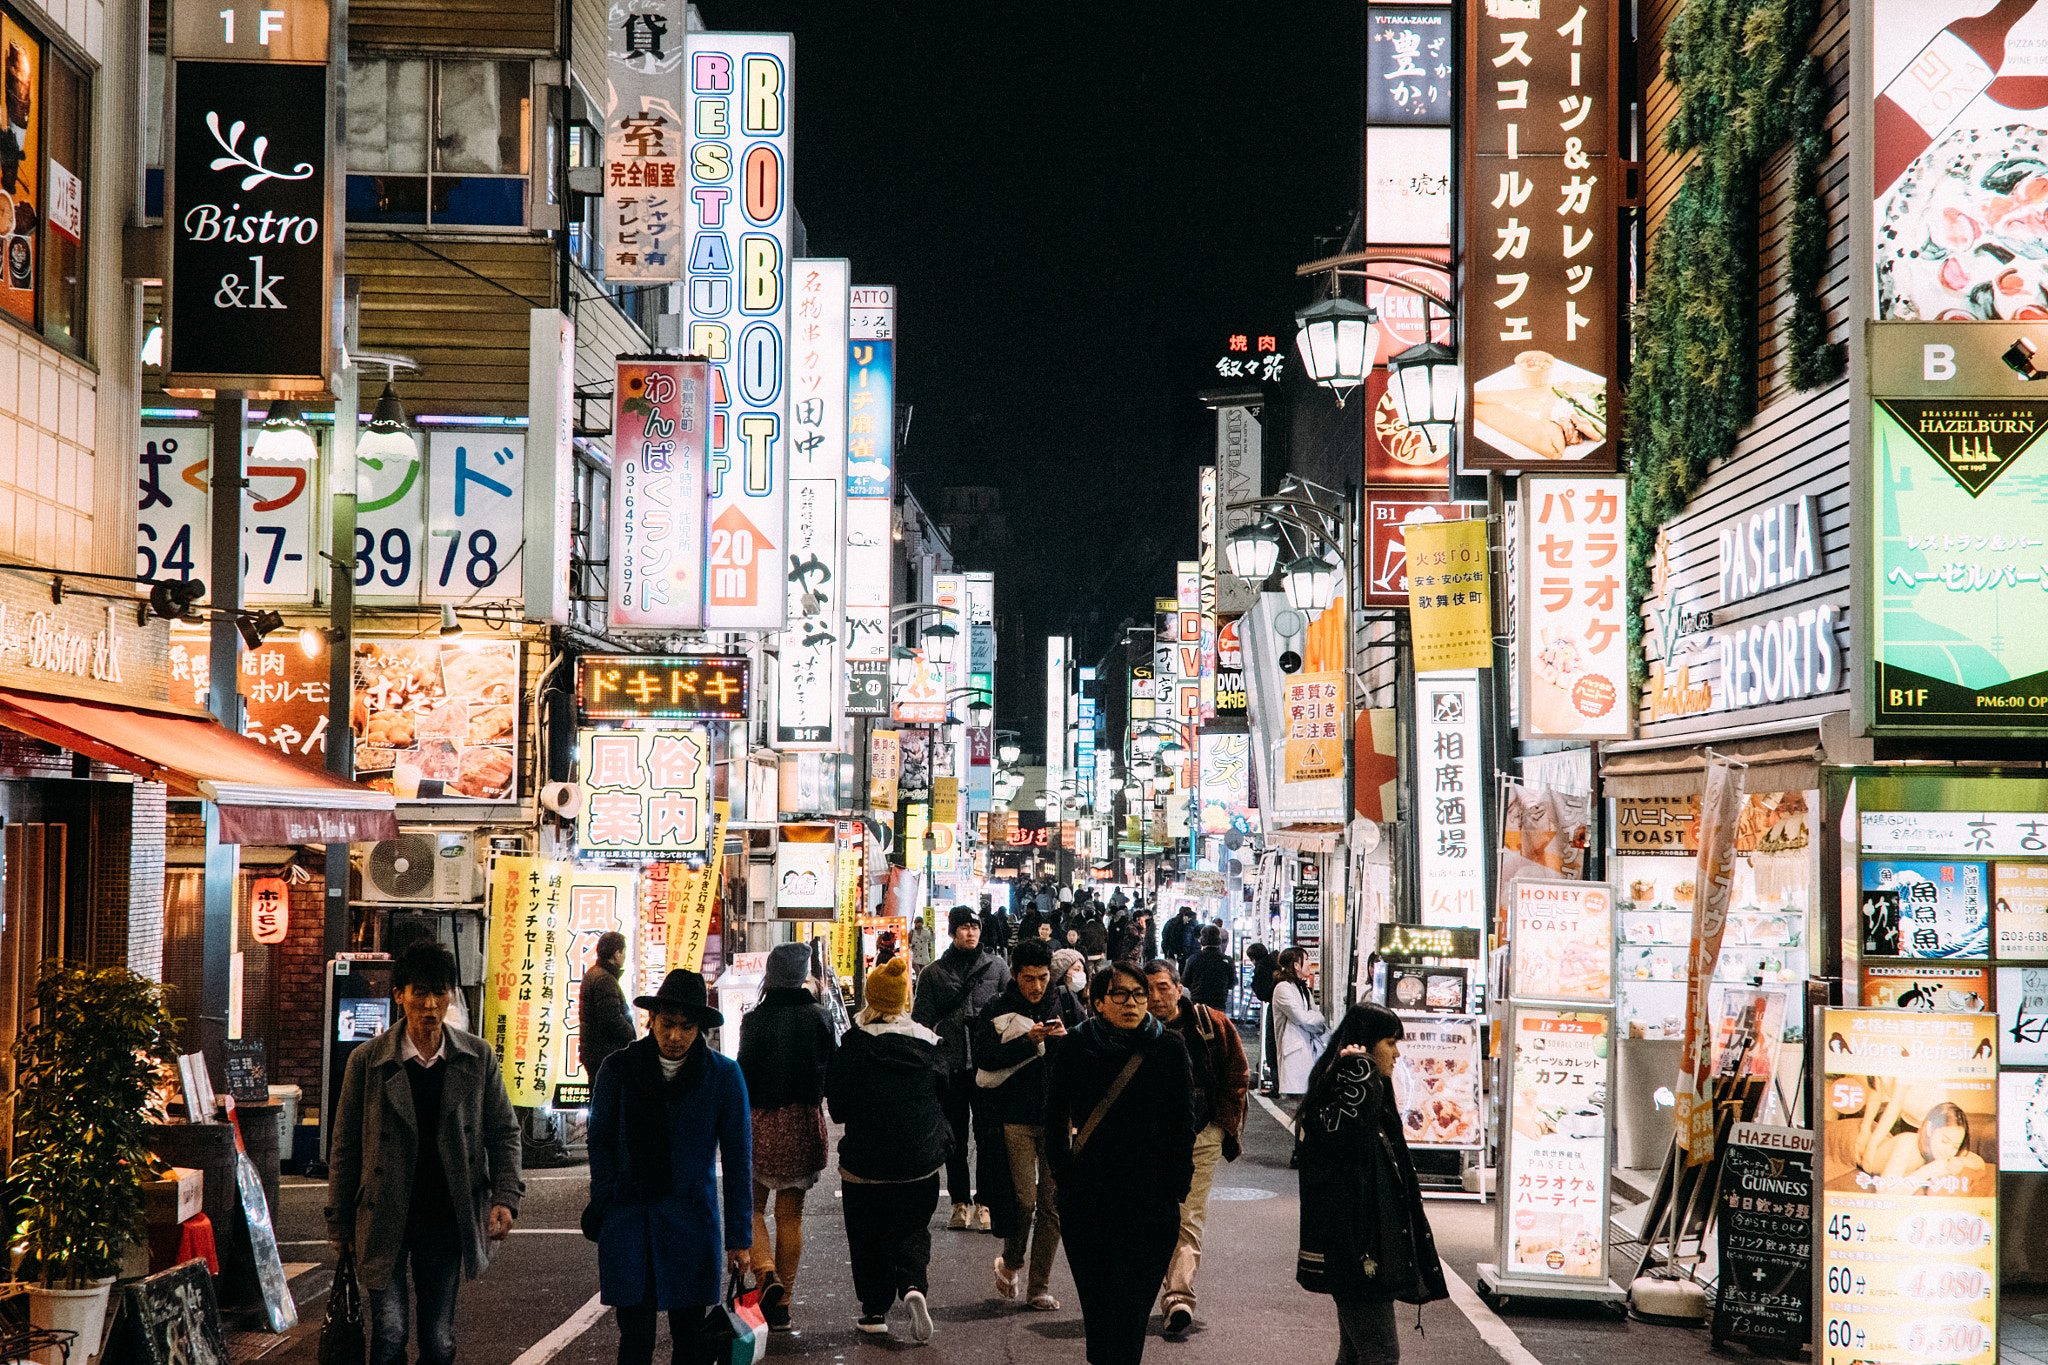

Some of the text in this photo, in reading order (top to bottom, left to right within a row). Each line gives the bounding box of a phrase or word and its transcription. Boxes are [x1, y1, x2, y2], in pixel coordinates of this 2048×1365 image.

[1375, 16, 1442, 25] YUTAKA-ZAKARI
[610, 162, 676, 188] 完全個室
[1490, 31, 1535, 341] スコールカフェ
[184, 203, 319, 245] Bistro
[616, 196, 640, 266] テレビ有
[644, 195, 668, 266] シャワー有
[213, 255, 288, 309] &k
[741, 53, 785, 497] ROBOT
[876, 329, 890, 339] 5F
[1229, 334, 1276, 352] 焼肉
[1215, 353, 1286, 382] 叙々苑
[680, 379, 694, 432] 歌舞伎町
[850, 345, 876, 459] リーチ麻雀
[1919, 419, 2036, 433] HAZELBURN
[640, 371, 677, 612] わんぱくランド
[854, 477, 870, 486] 4F
[1377, 508, 1396, 520] B1
[624, 462, 636, 607] 03-6457-3978
[1907, 534, 2043, 552] レストラン&バー
[711, 529, 753, 567] 20
[1537, 488, 1577, 614] パセラ
[1719, 494, 1824, 605] PASELA
[716, 567, 747, 599] m
[1414, 571, 1484, 587] 安全・安心な街
[1583, 488, 1621, 656] カラオケ
[1418, 591, 1483, 609] 歌舞伎町
[28, 609, 88, 678] Bistro
[870, 645, 885, 655] 2F
[365, 653, 425, 669] とくちゃん
[1719, 604, 1838, 710] RESORTS
[363, 673, 456, 716] ホルモン
[593, 669, 741, 705] ドキドキ
[868, 682, 880, 694] 2F
[1290, 683, 1338, 701] 悪質な
[1889, 688, 1929, 706] B1F
[865, 697, 887, 714] walk
[1290, 702, 1337, 721] 客引き
[1976, 695, 2025, 707] PM6:00
[1290, 722, 1338, 740] に注意
[586, 735, 702, 790] 風俗
[1433, 731, 1468, 859] 相席酒場
[587, 790, 699, 846] 案内
[1619, 808, 1694, 826] ハニトー
[1621, 829, 1687, 845] TOAST
[1521, 889, 1581, 902] HONEY
[257, 889, 280, 939] ホルモン
[1520, 918, 1579, 932] TOAST
[494, 871, 521, 1001] 見かけたらすぐ110番
[1420, 1032, 1437, 1042] OUT
[1558, 1022, 1584, 1033] カフェ
[1850, 1036, 1974, 1061] More Refresh
[1535, 1069, 1585, 1086] カフェ
[1832, 1083, 1865, 1109] 5F
[1528, 1159, 1586, 1171] PASELA
[1518, 1173, 1596, 1192] カラオケ&
[1741, 1174, 1808, 1197] GUINNESS
[1828, 1213, 1867, 1242] 45分
[1828, 1265, 1867, 1295] 60分
[1828, 1318, 1867, 1348] 60分
